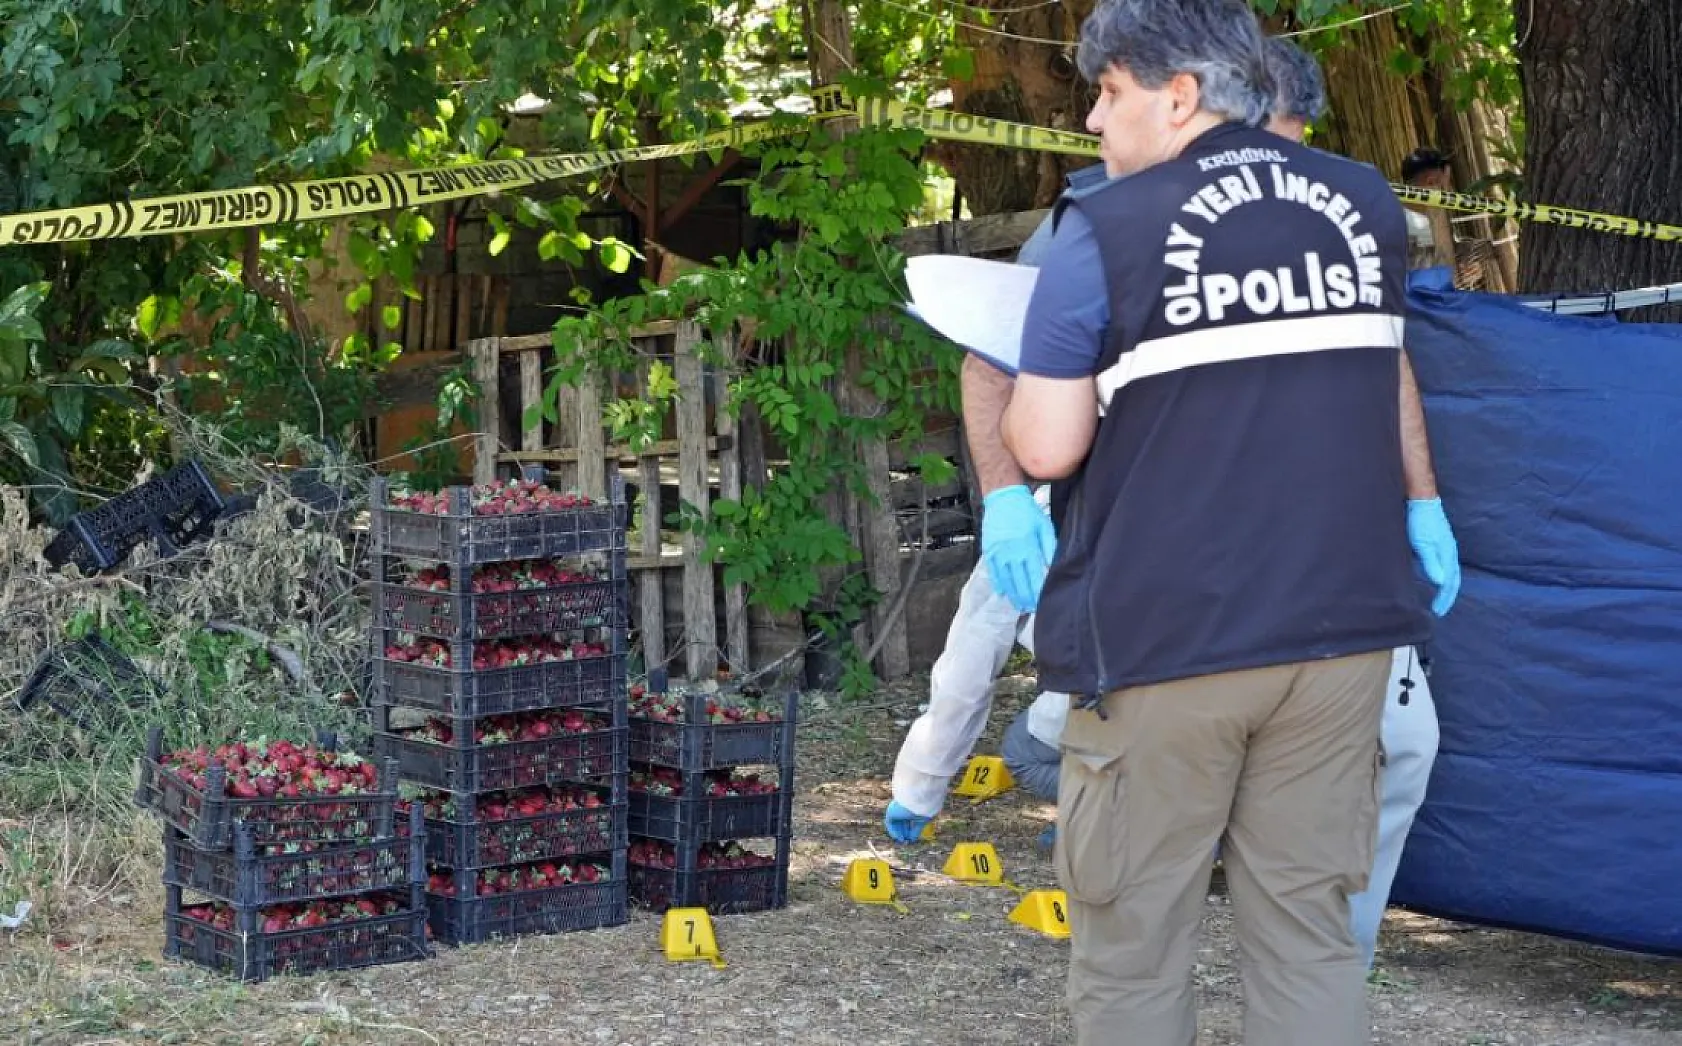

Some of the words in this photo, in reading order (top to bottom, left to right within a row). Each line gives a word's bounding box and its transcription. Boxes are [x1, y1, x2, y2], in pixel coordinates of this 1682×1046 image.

[307, 177, 383, 211] POLİS
[407, 161, 520, 197] GİRİLMEZ
[1181, 164, 1263, 223] YERİ
[13, 211, 102, 243] POLİS
[140, 191, 273, 232] GİRİLMEZ
[1270, 163, 1383, 308] İNCELEME
[1163, 222, 1204, 326] OLAY
[1202, 251, 1358, 321] POLİS
[972, 766, 990, 785] 12
[868, 868, 878, 889] 9
[970, 853, 989, 874] 10
[1053, 902, 1065, 923] 8
[684, 920, 695, 944] 7
